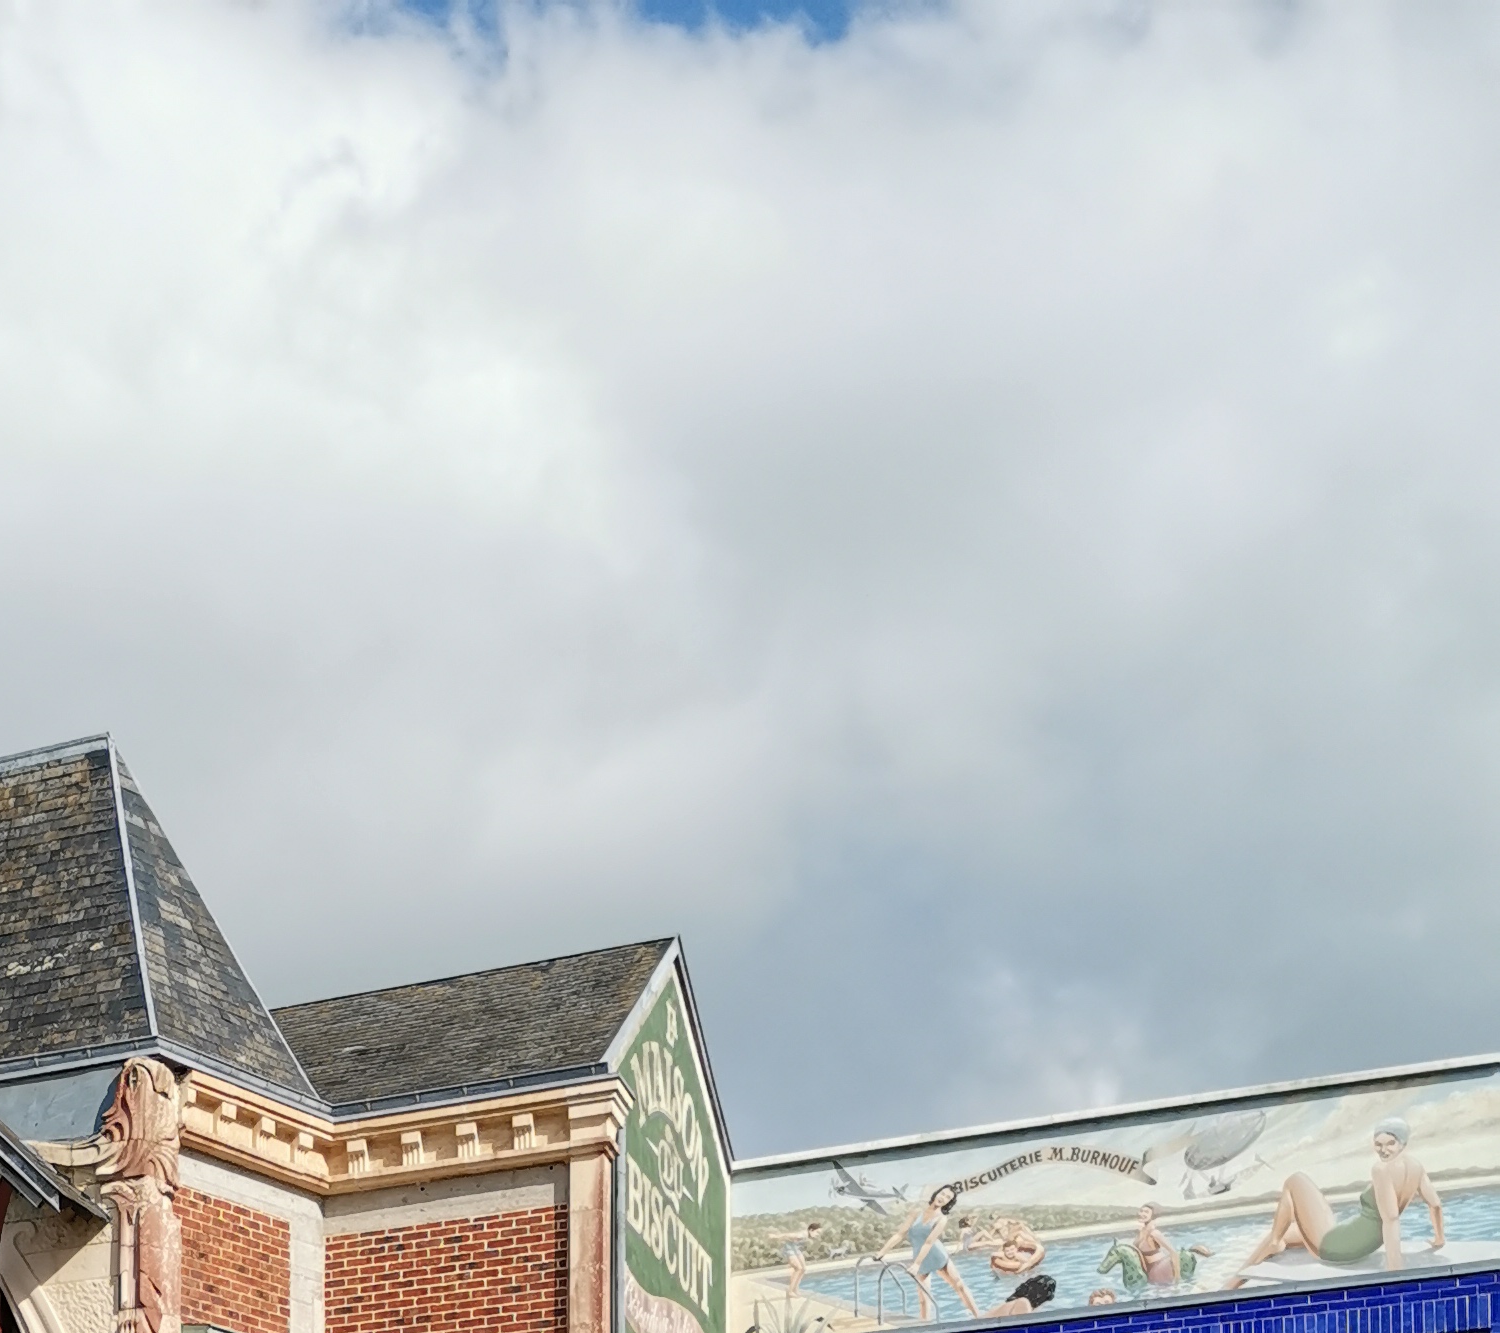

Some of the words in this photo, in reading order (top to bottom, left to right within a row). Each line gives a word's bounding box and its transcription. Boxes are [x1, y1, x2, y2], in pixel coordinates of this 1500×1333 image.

[630, 1040, 709, 1208] MAISON
[658, 1124, 685, 1214] DU
[952, 1150, 1043, 1195] BISCUITERIE
[626, 1152, 714, 1318] BISCUIT
